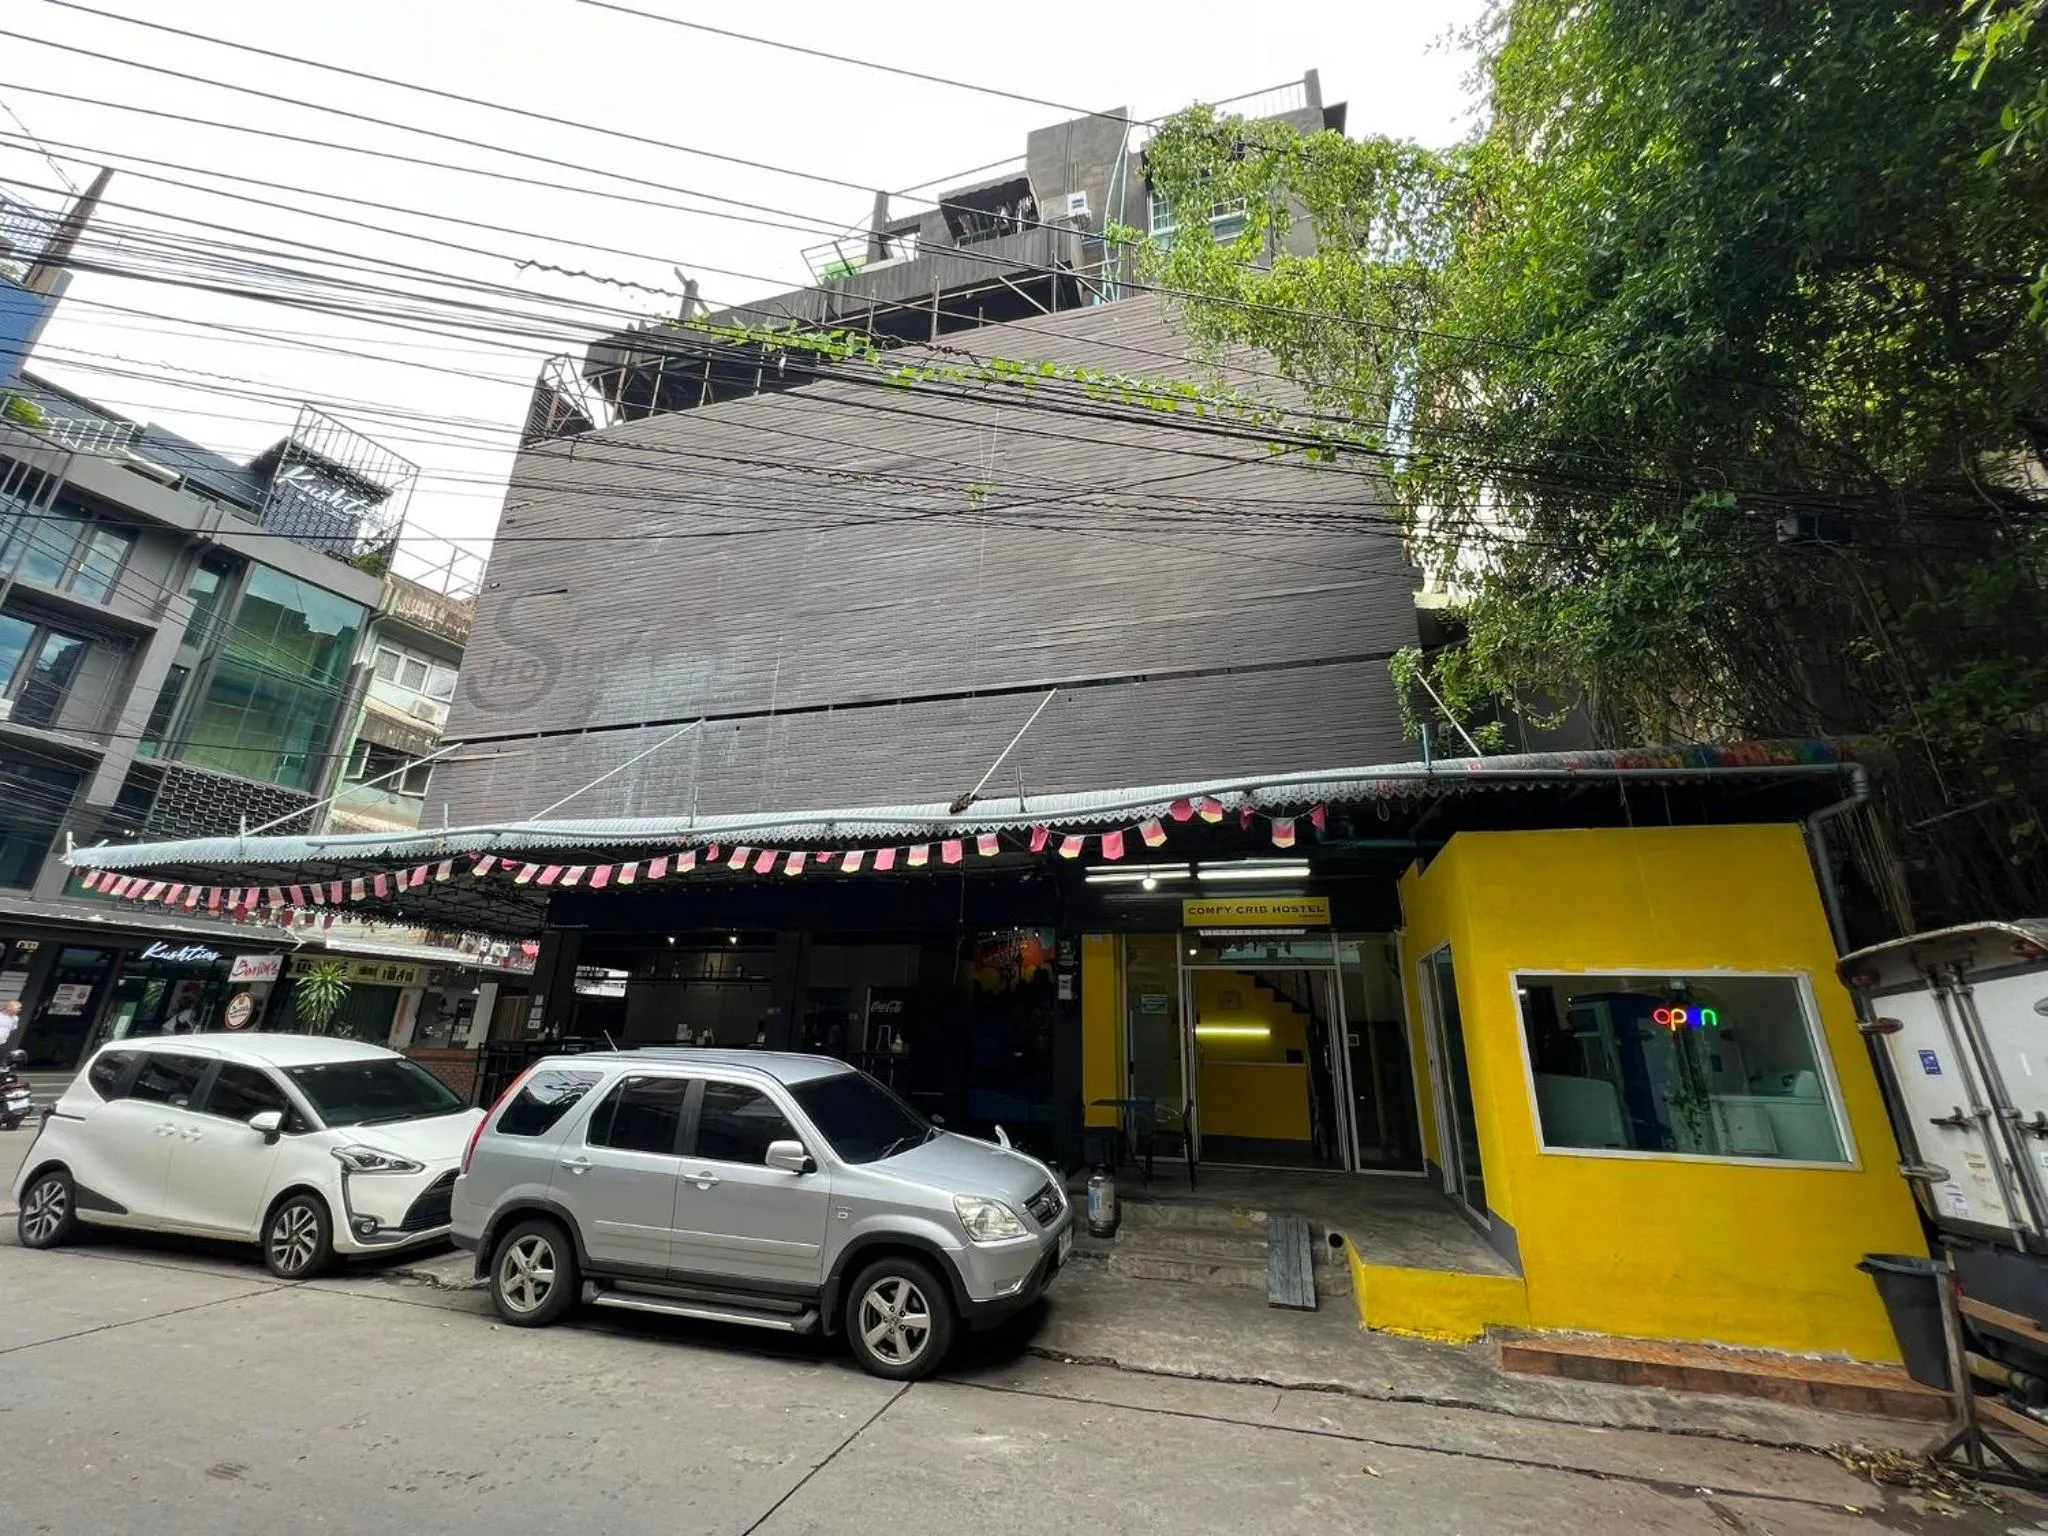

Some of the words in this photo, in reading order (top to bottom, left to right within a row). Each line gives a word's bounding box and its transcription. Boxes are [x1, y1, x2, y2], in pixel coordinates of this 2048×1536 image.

[1188, 906, 1233, 916] COMFY
[1235, 906, 1267, 914] CRIB
[1272, 904, 1324, 913] HOSTEL
[1653, 1008, 1717, 1031] open
